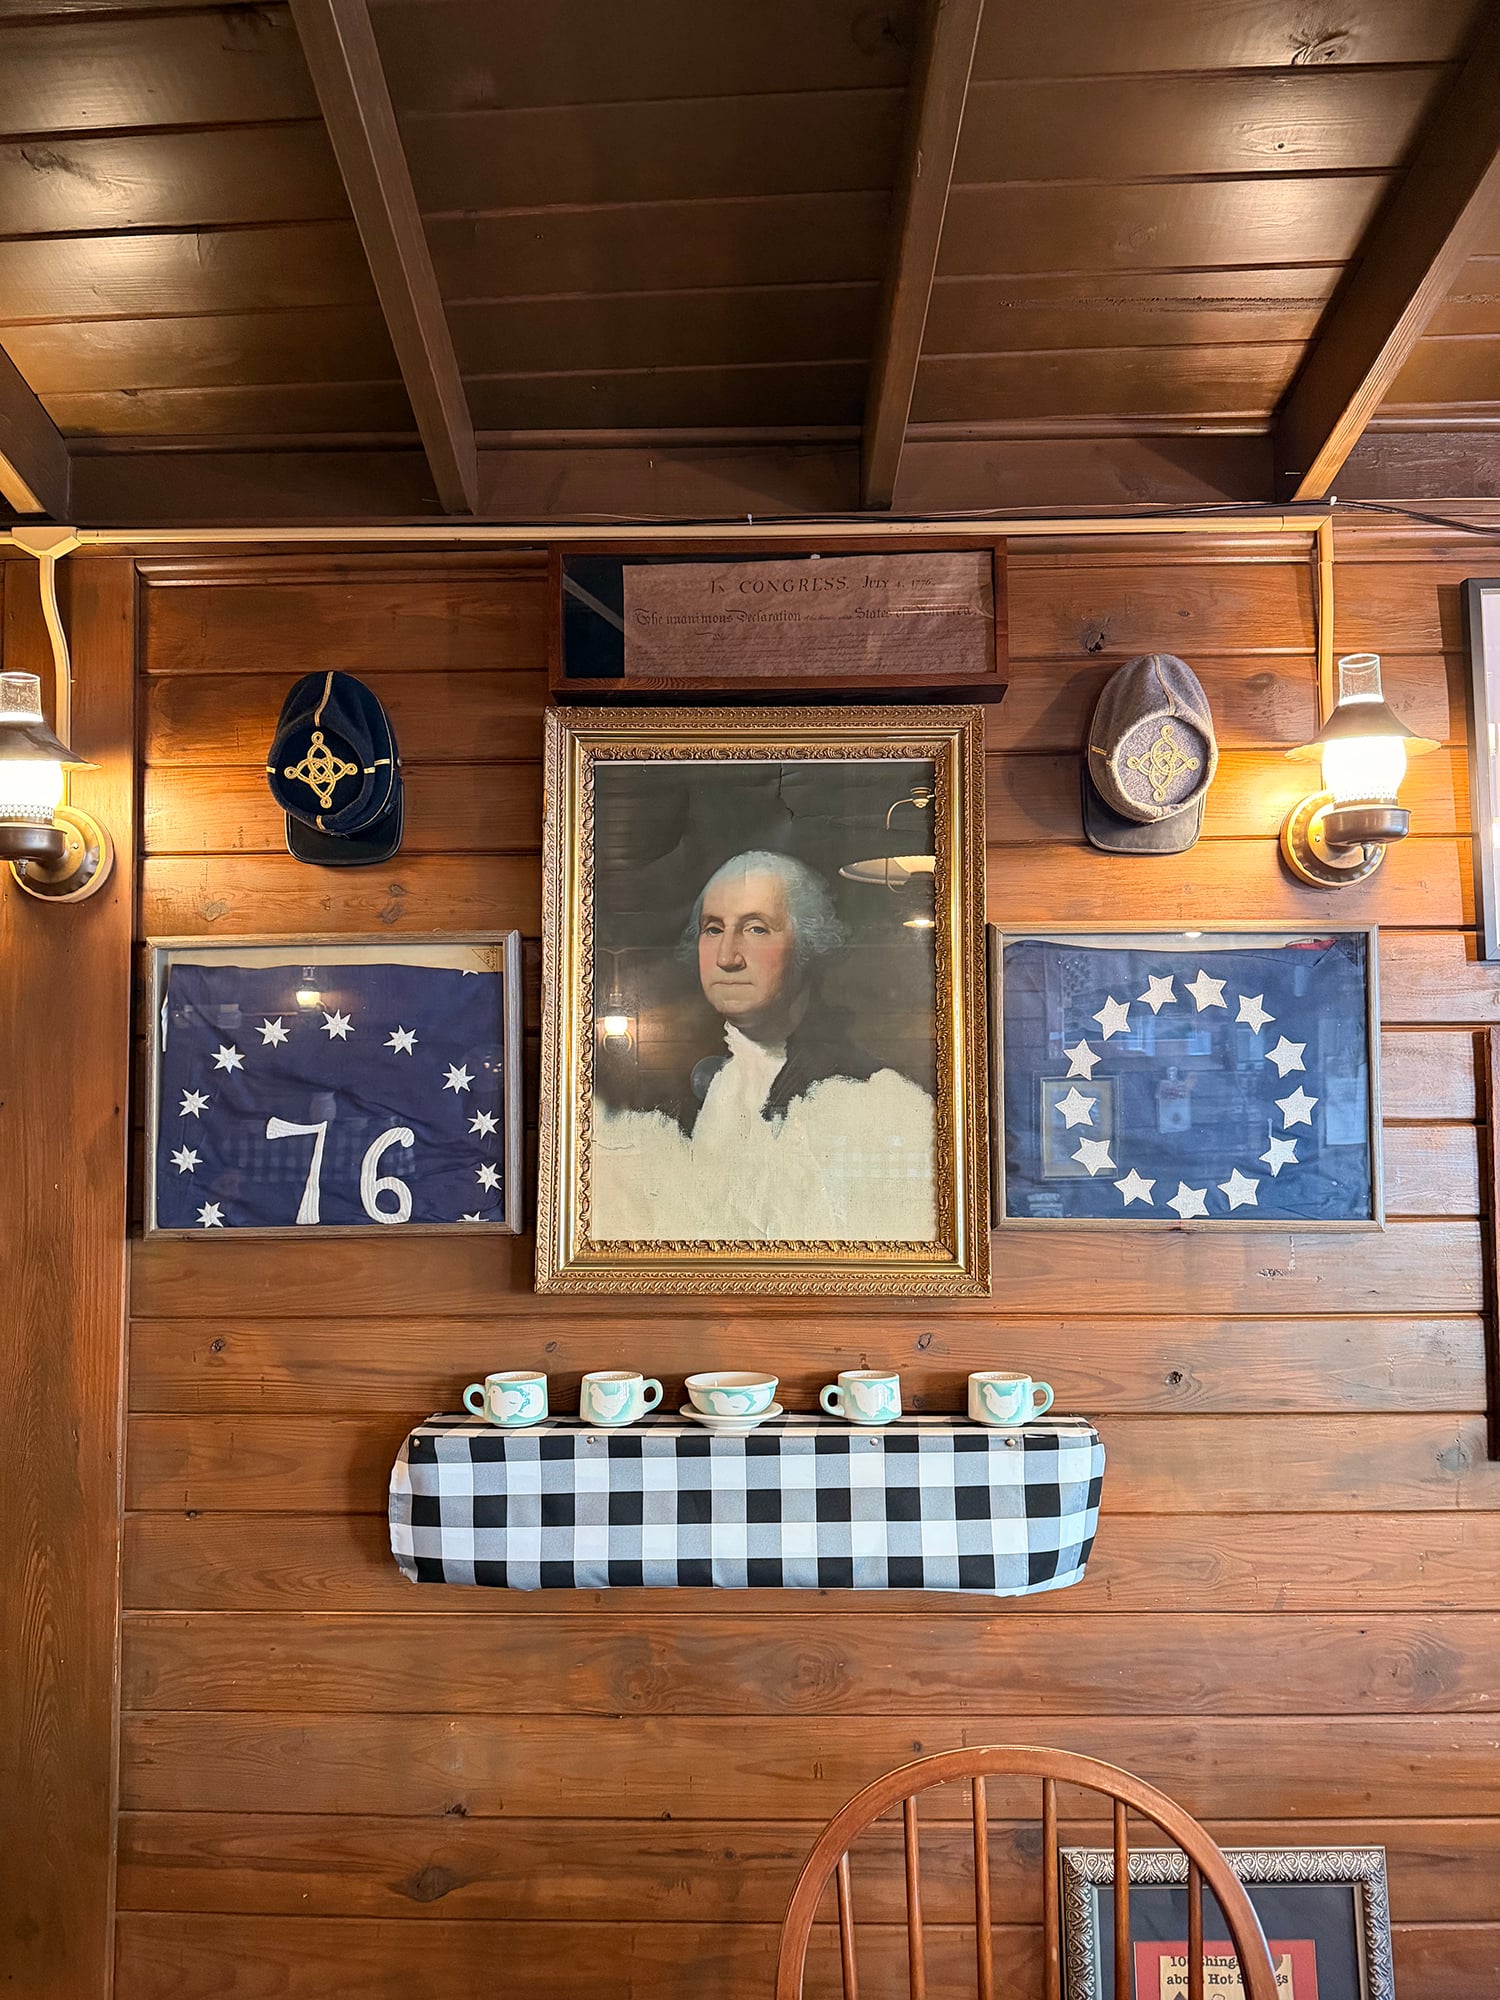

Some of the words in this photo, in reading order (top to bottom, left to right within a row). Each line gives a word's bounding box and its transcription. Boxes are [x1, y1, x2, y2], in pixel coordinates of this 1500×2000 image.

[634, 608, 663, 626] The
[666, 613, 733, 625] unanimous
[727, 609, 801, 623] Declaration
[854, 606, 893, 619] States
[266, 1117, 415, 1224] 76
[1202, 1955, 1241, 1969] hing
[1166, 1973, 1190, 1985] abo
[1208, 1973, 1234, 1985] Hot
